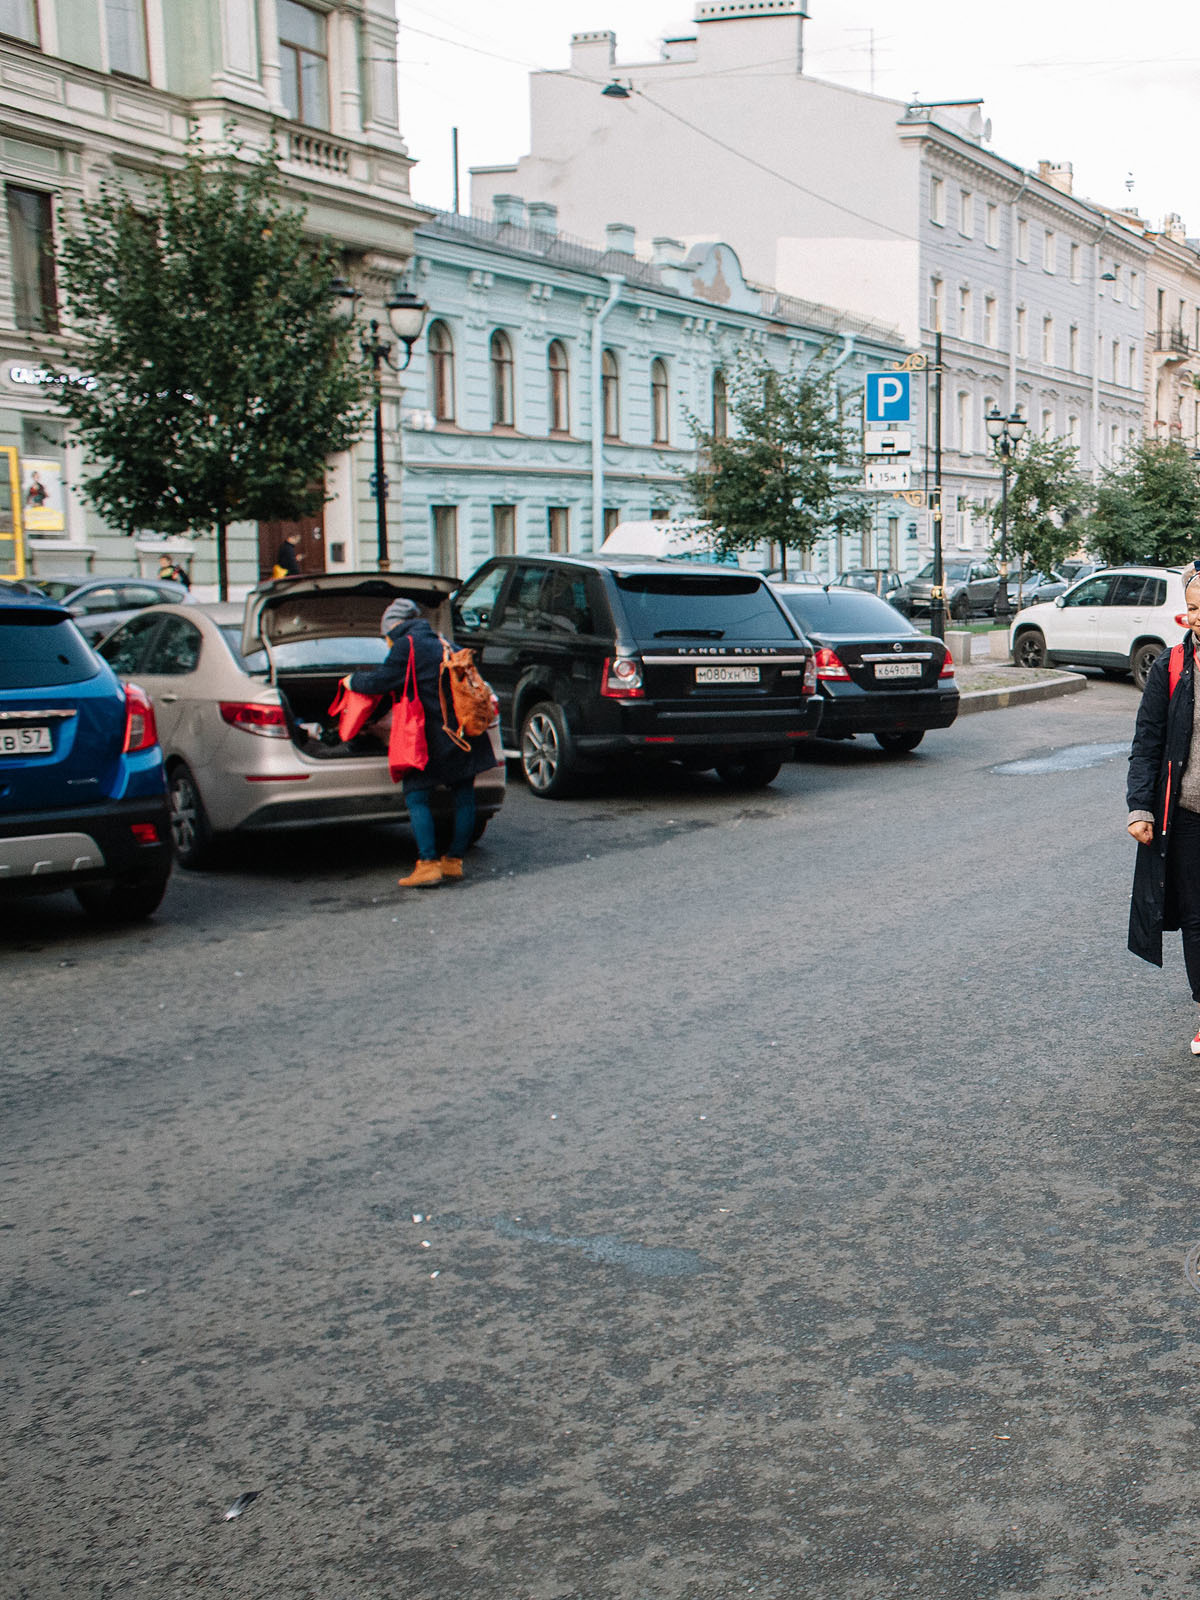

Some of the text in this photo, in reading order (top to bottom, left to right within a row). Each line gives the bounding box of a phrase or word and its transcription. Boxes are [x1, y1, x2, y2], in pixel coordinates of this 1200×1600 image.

[877, 377, 903, 417] P
[678, 647, 777, 655] RANGE ROVER
[21, 730, 42, 745] 57
